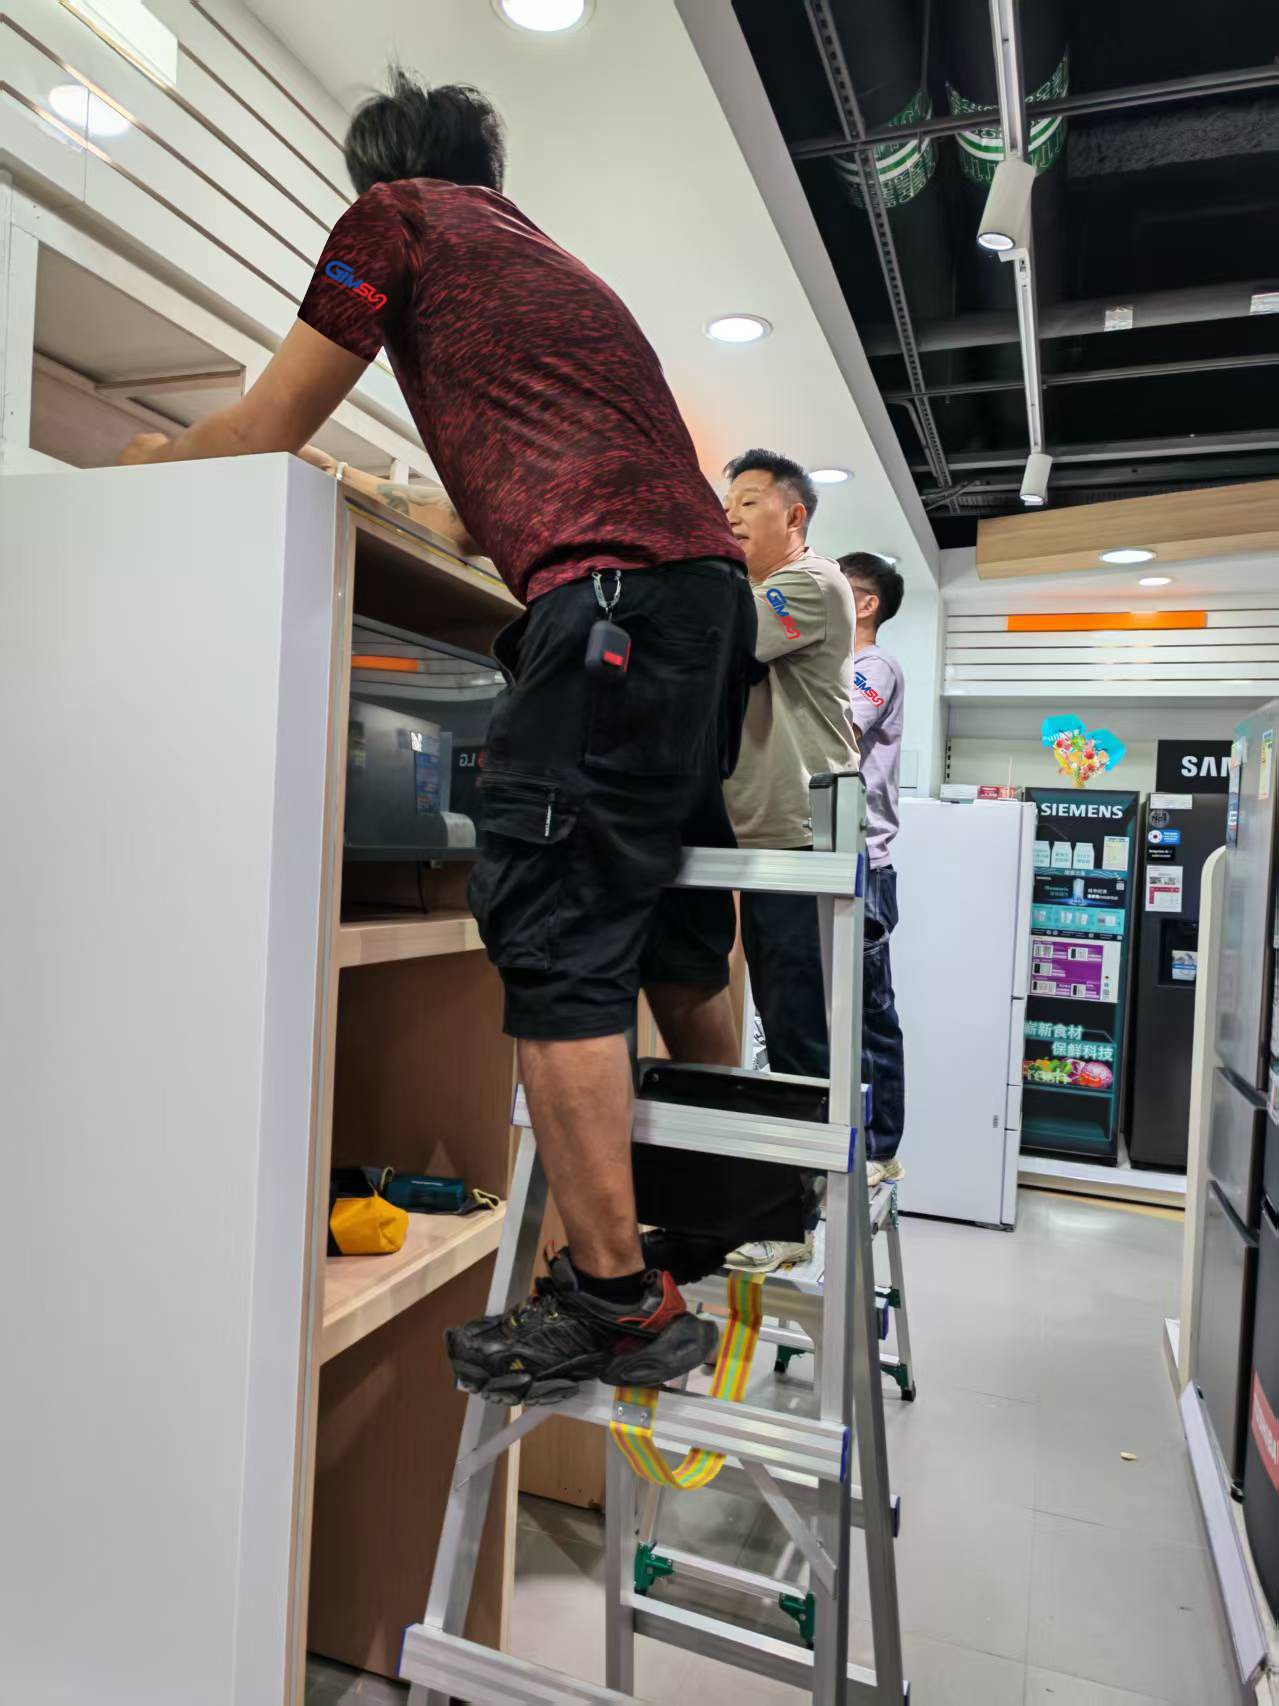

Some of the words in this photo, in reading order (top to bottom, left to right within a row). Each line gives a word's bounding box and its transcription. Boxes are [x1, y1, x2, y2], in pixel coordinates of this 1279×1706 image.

[1040, 802, 1123, 819] SIEMENS
[1051, 1041, 1114, 1061] 保鲜科技
